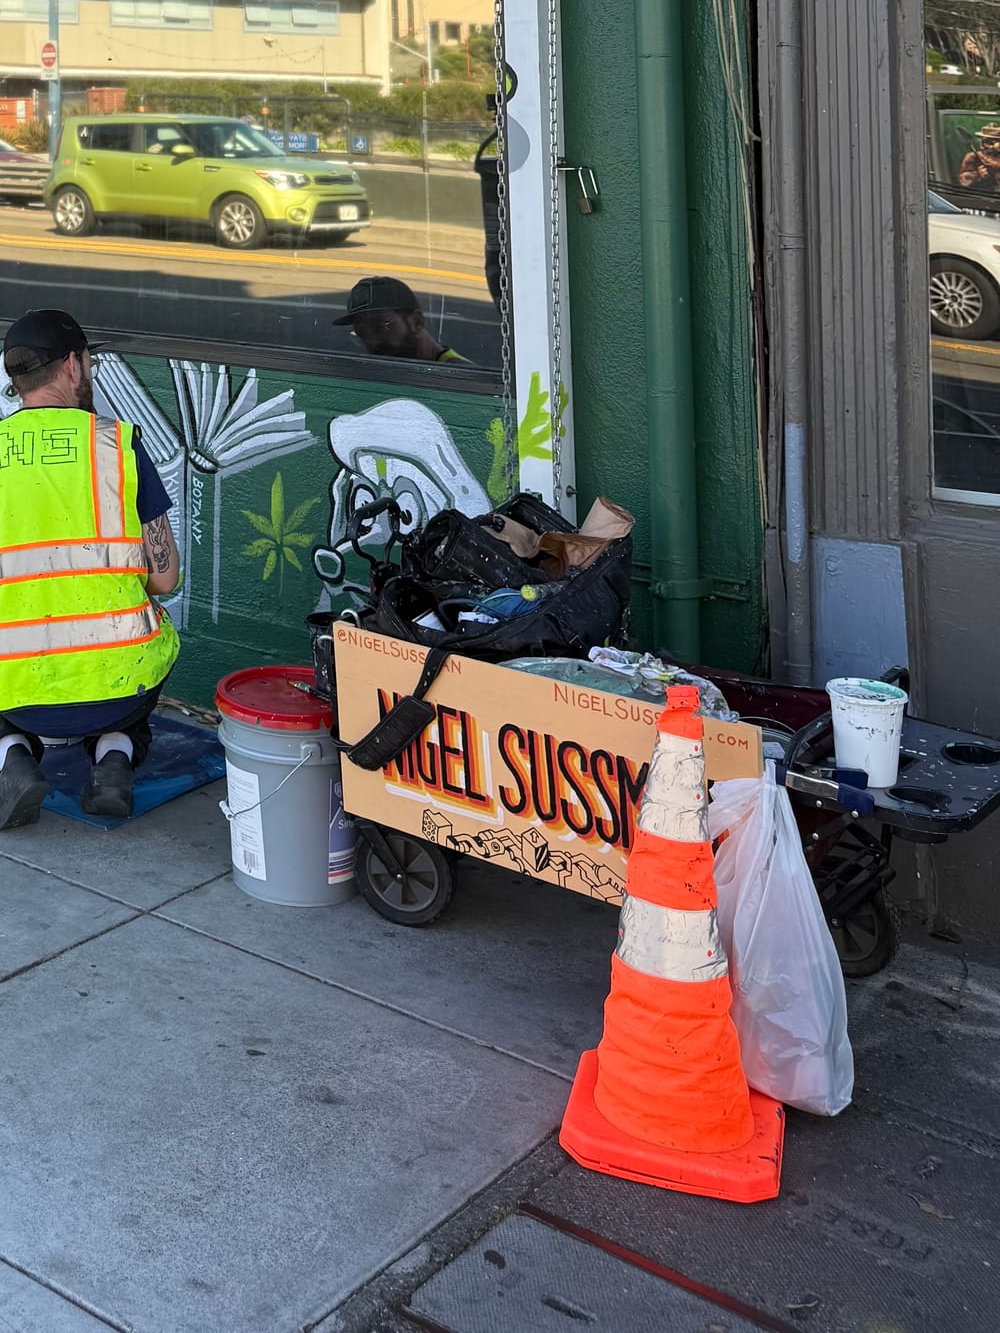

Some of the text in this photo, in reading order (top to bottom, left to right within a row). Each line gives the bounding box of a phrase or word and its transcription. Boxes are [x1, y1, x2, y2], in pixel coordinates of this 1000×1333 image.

[191, 475, 204, 546] BOTANY
[337, 628, 462, 675] @NIGELSUSSAN
[553, 682, 749, 751] NIGELSUSS.COM
[498, 722, 652, 850] SUSSM
